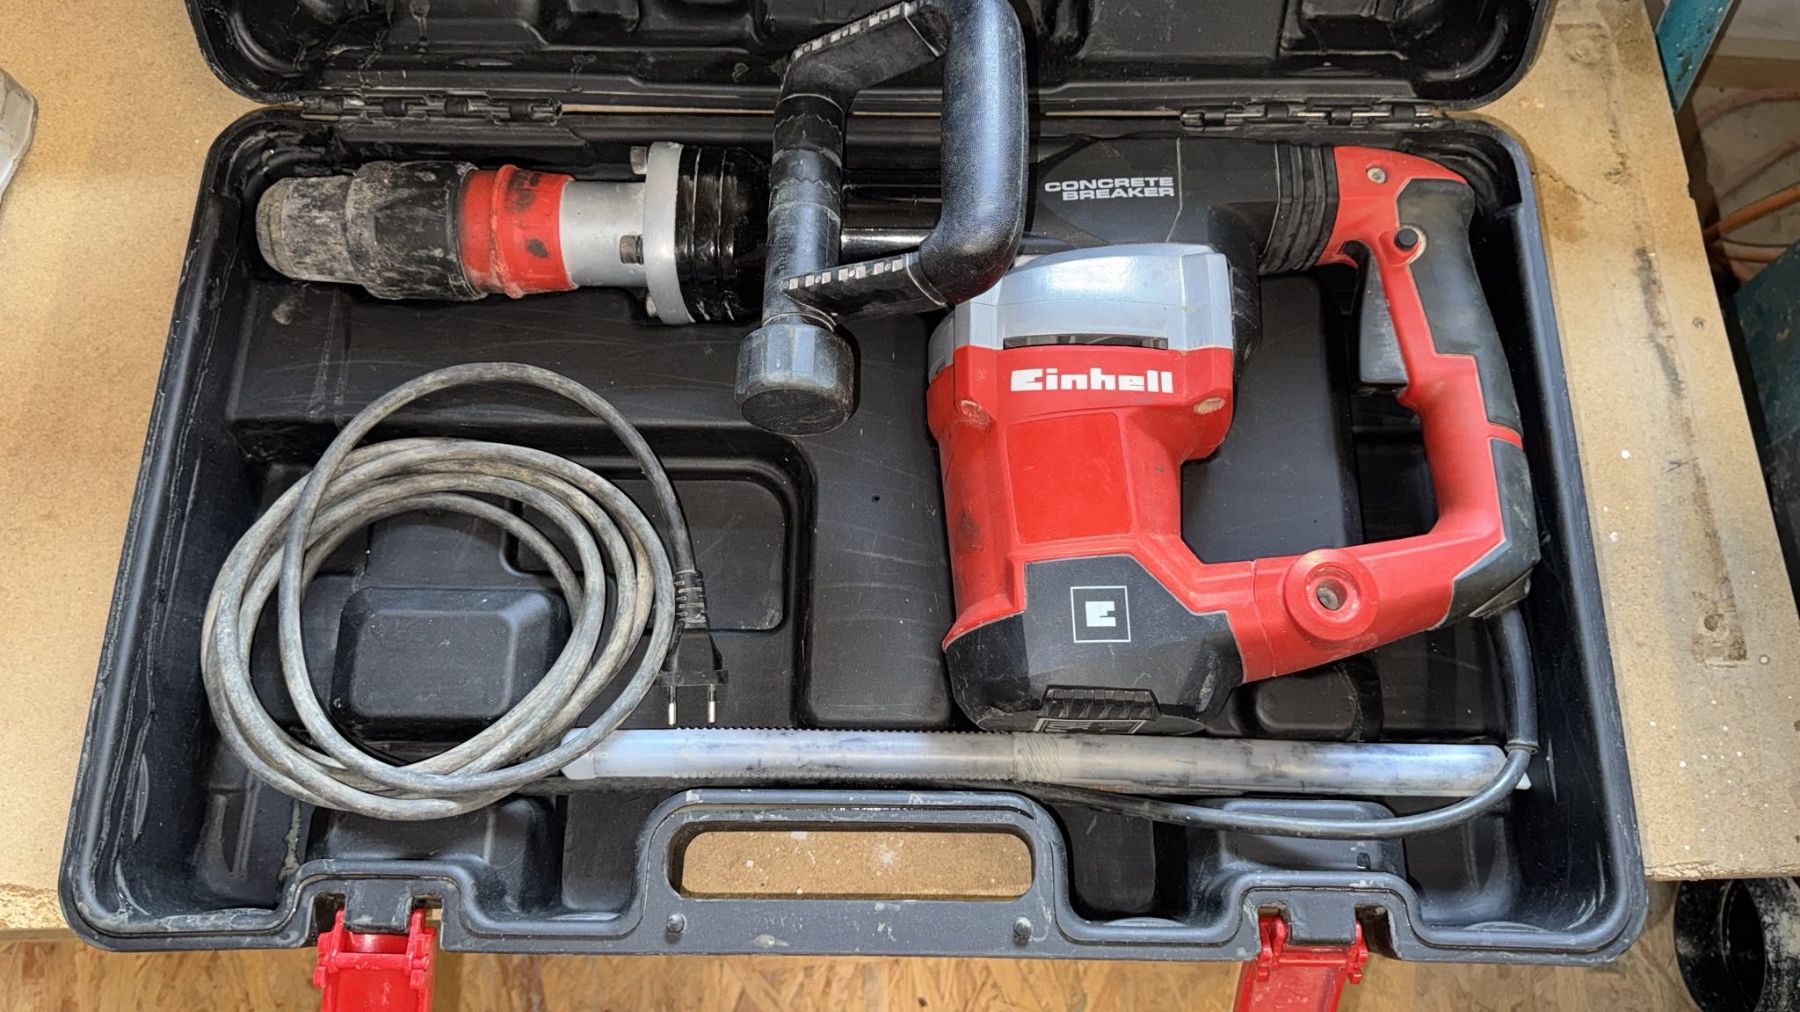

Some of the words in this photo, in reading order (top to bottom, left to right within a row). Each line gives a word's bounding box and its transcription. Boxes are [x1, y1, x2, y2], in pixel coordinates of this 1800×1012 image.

[1045, 177, 1174, 192] CONCRETE
[1062, 187, 1175, 201] BREAKER
[1011, 368, 1173, 394] Einhell
